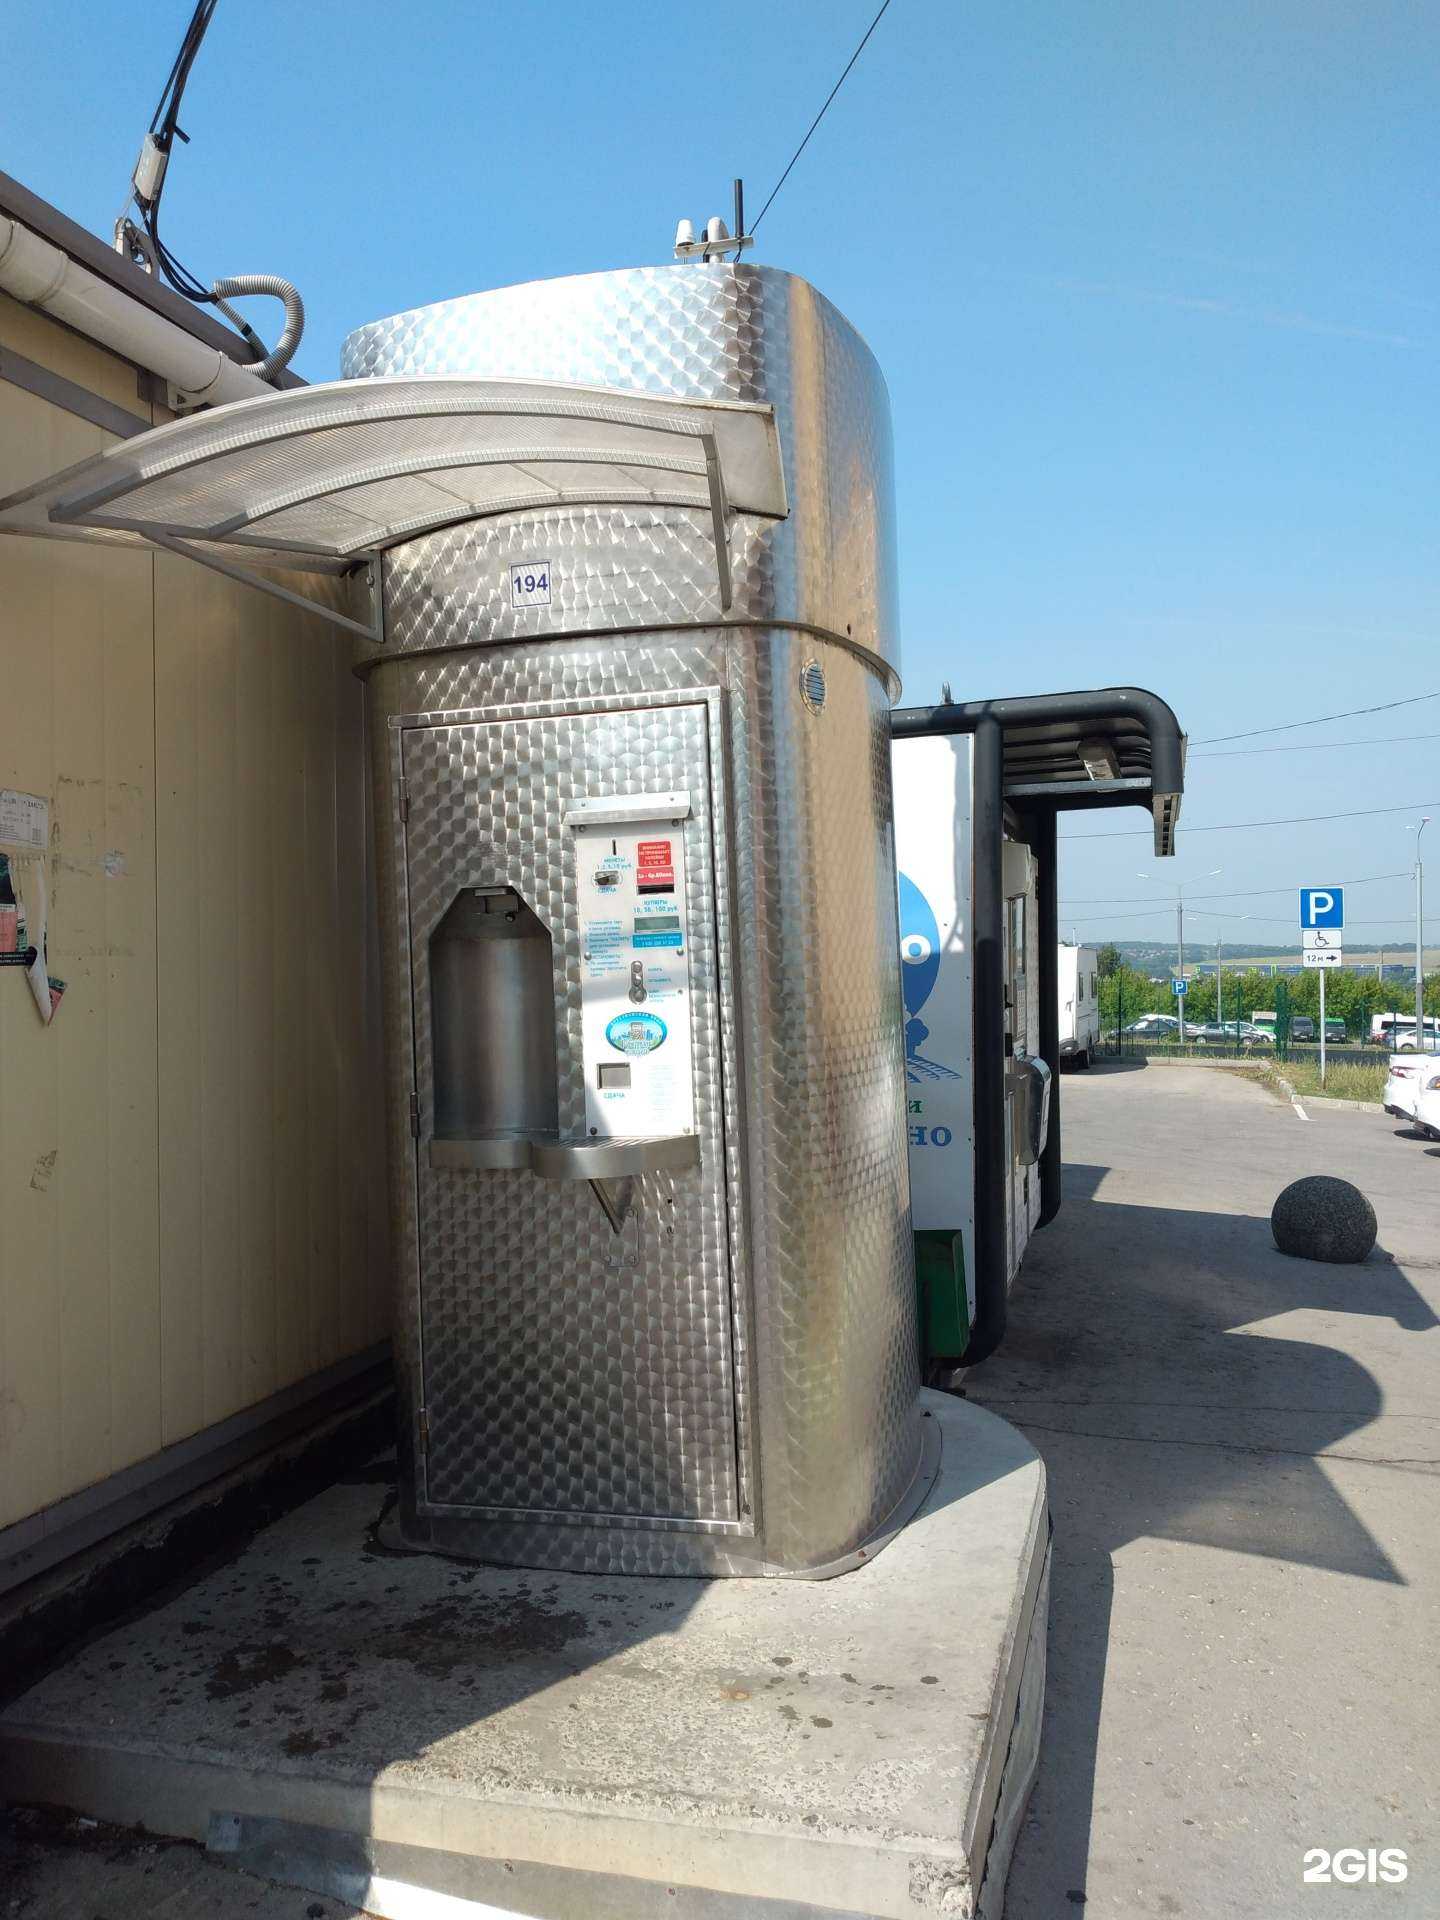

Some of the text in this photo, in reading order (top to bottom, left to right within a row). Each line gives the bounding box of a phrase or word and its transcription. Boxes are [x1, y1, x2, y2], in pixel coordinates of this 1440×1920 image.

[514, 573, 548, 594] 194
[1309, 892, 1334, 925] P
[1175, 981, 1184, 993] P
